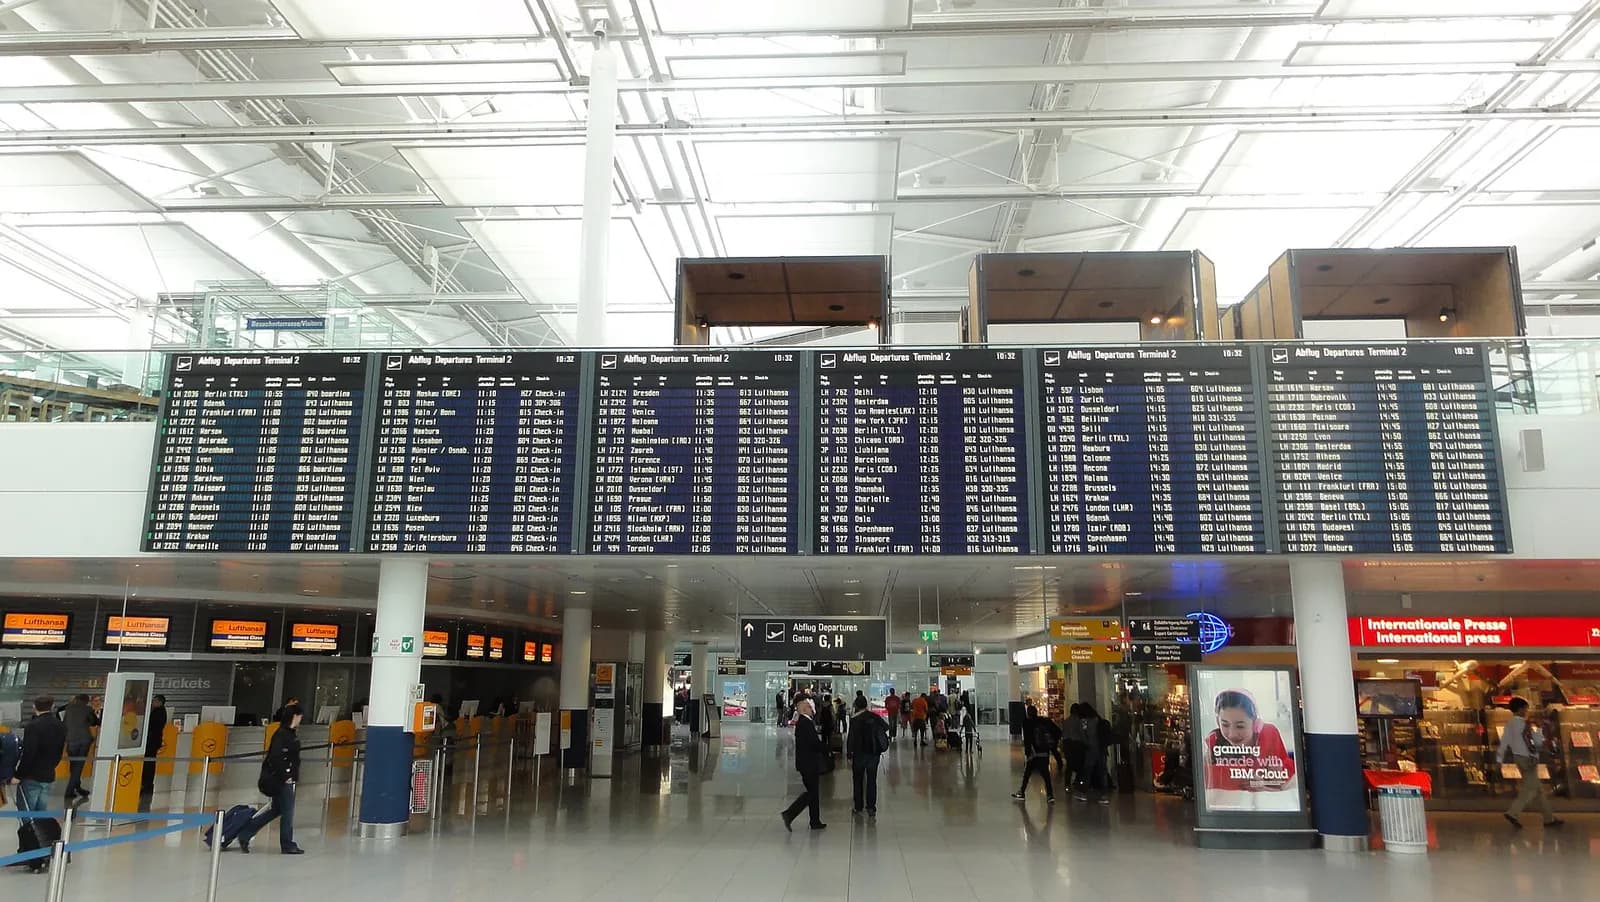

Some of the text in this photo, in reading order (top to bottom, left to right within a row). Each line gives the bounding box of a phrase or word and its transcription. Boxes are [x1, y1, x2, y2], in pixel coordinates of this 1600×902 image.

[1068, 351, 1091, 360] Abflug
[1171, 350, 1176, 358] 2
[1296, 348, 1319, 358] Abflug
[1368, 348, 1399, 356] Terminal
[1401, 347, 1406, 355] 2
[198, 357, 220, 366] Abflug
[224, 357, 260, 365] Departures
[409, 356, 431, 365] Abflug
[435, 356, 472, 364] Departures
[624, 355, 646, 364] Abflug
[843, 353, 866, 363] Abflug
[793, 624, 816, 632] Abflug
[1368, 619, 1507, 630] Internationale Presse
[819, 635, 830, 648] G,
[835, 635, 843, 647] H
[1377, 632, 1500, 646] International press
[1213, 744, 1260, 756] gaming
[1216, 756, 1283, 766] made with
[1230, 769, 1288, 779] IBM Cloud
